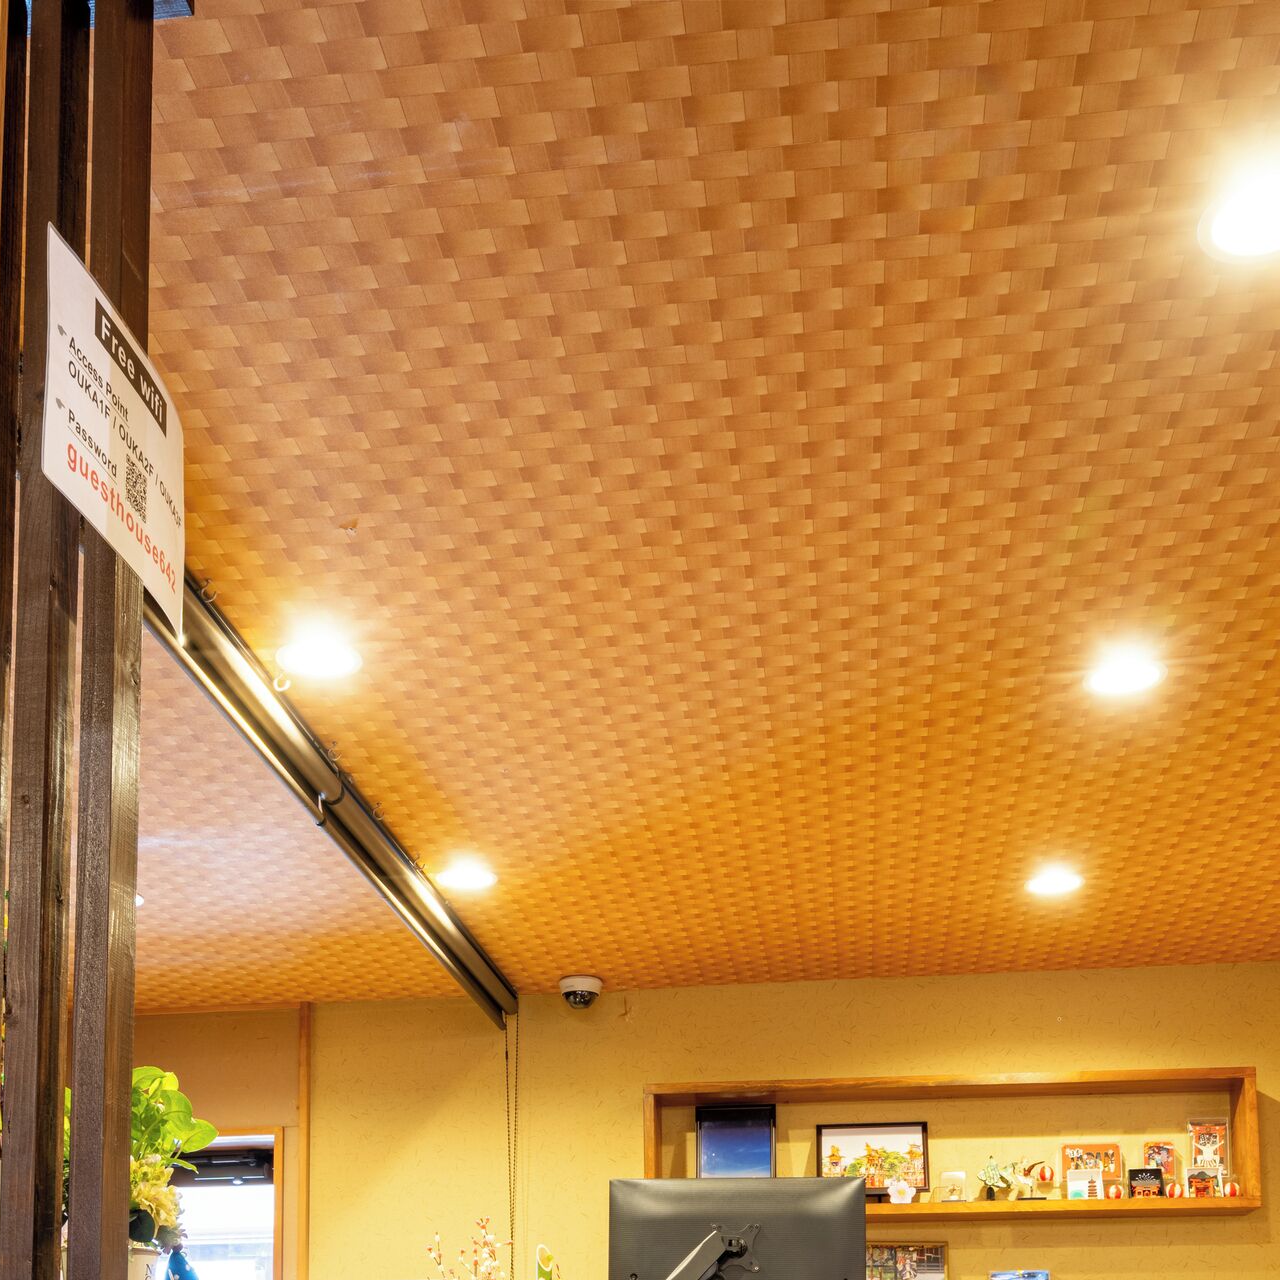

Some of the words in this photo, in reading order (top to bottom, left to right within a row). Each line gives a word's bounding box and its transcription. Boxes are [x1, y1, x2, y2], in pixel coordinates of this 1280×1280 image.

[68, 336, 104, 392] Access
[105, 380, 130, 423] Point
[100, 315, 135, 380] Free
[140, 374, 165, 425] wifi
[68, 407, 118, 478] Password
[68, 361, 111, 421] OUKA1F
[118, 421, 155, 481] OUKA2F
[159, 480, 183, 529] OUKA3F
[66, 440, 177, 595] guesthouse642
